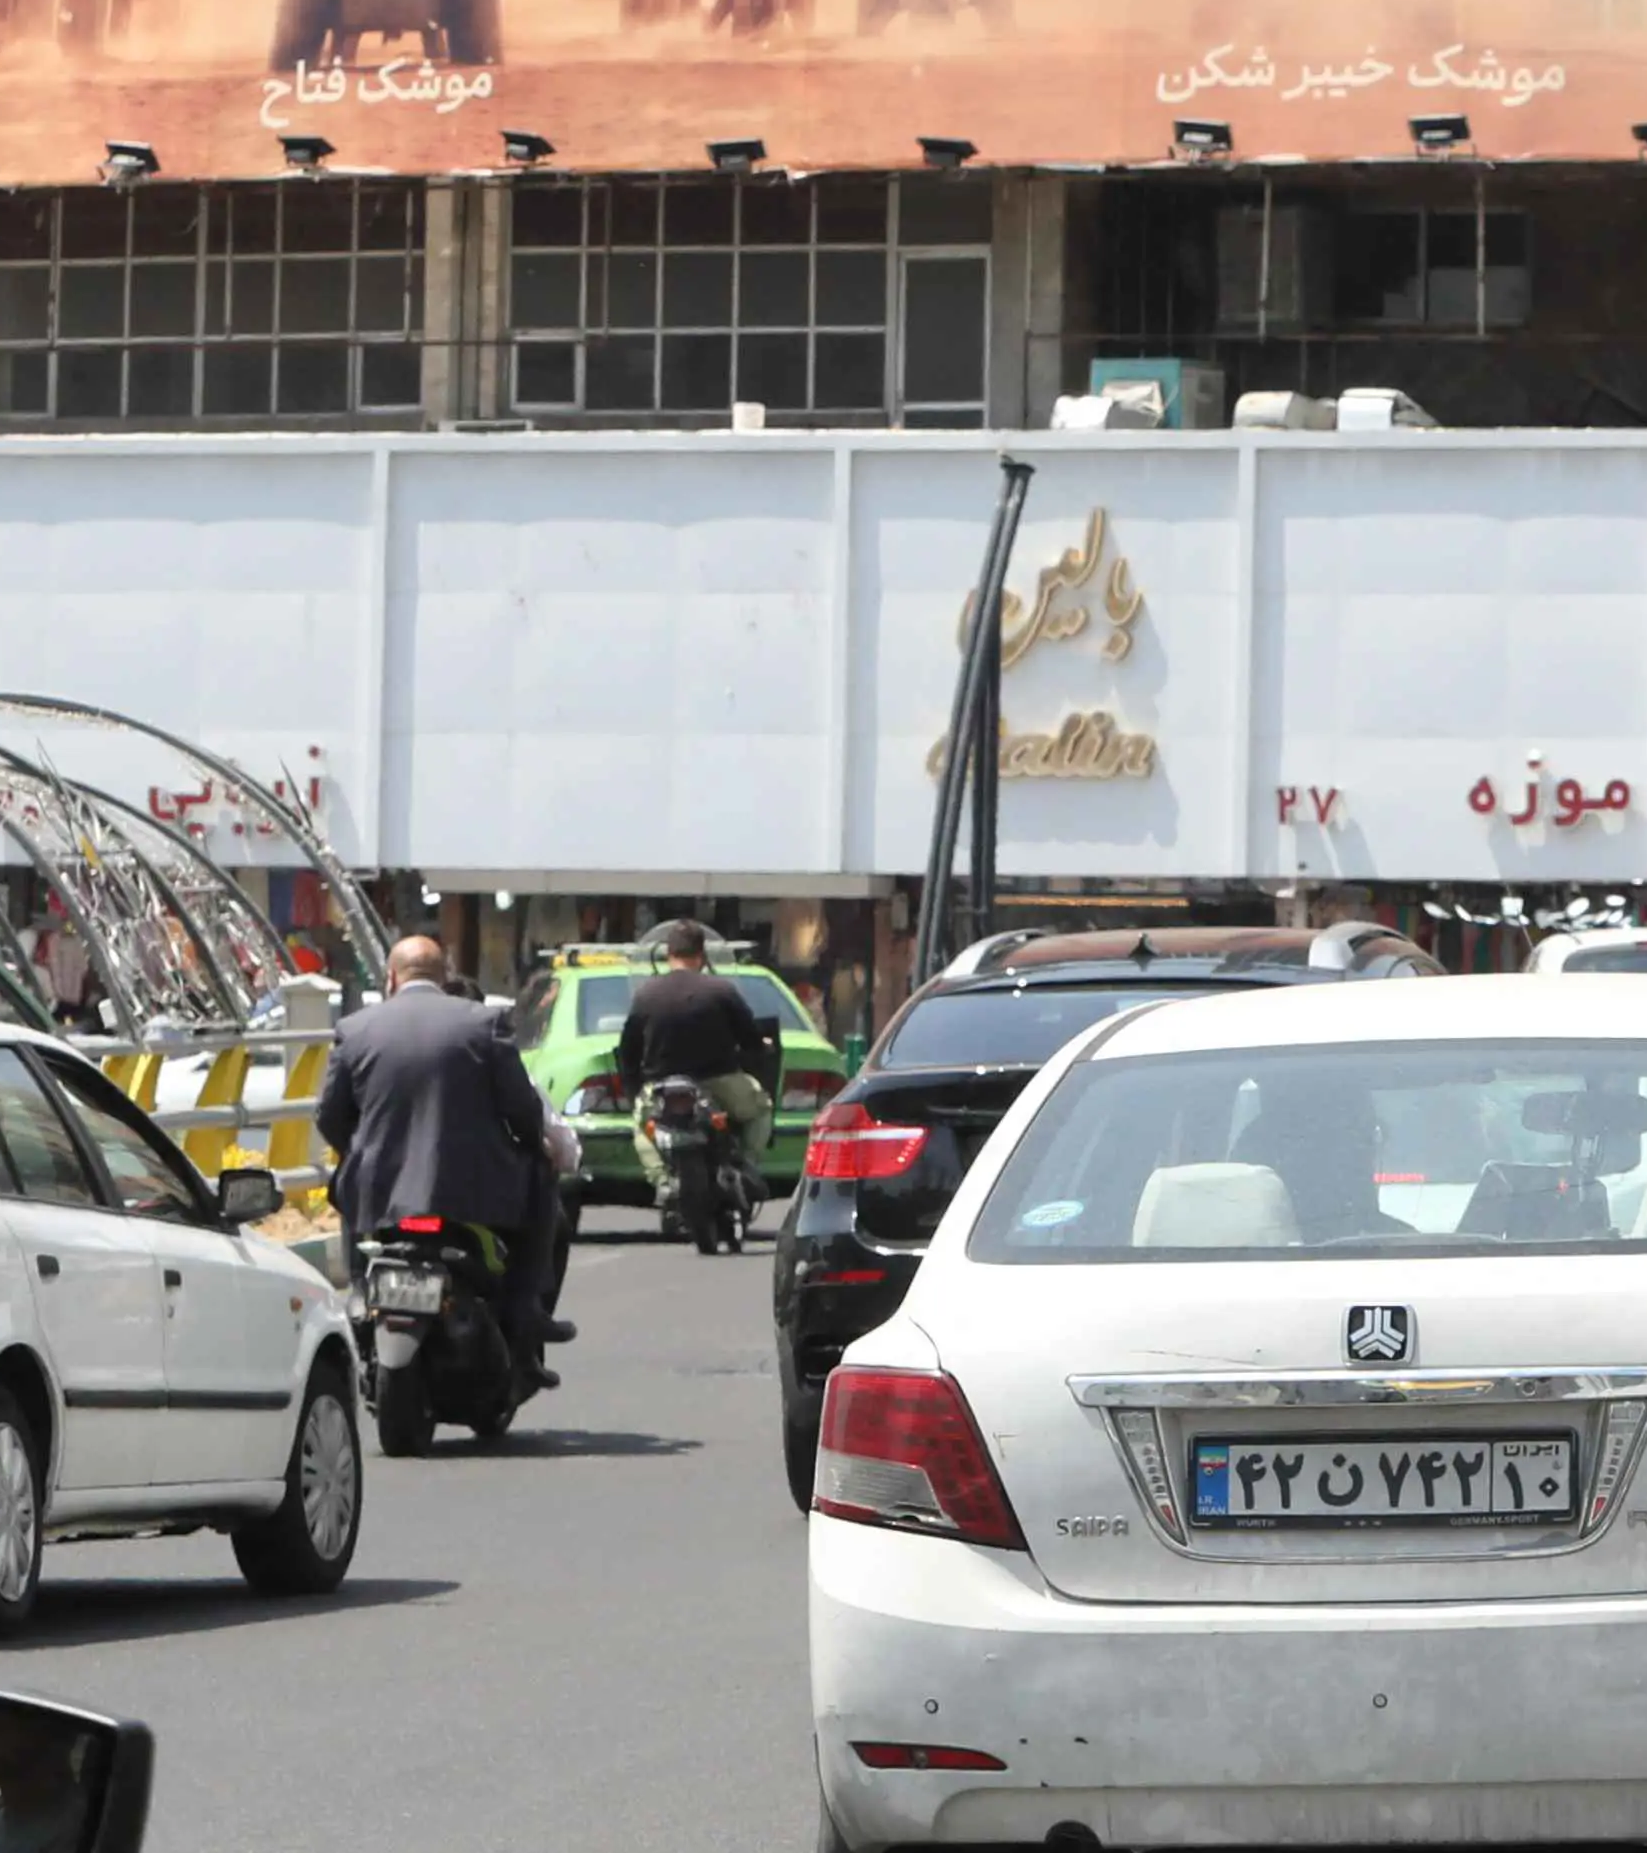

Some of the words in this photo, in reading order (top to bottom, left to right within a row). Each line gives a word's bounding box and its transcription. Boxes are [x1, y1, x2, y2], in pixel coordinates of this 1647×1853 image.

[259, 55, 347, 128] فتاح
[357, 56, 494, 114] موشک
[1155, 44, 1276, 103] شکن
[1281, 45, 1394, 101] خیبر
[1407, 44, 1566, 106] موشک
[1503, 1461, 1561, 1510] ۱۰
[1056, 1515, 1131, 1539] SAIPA
